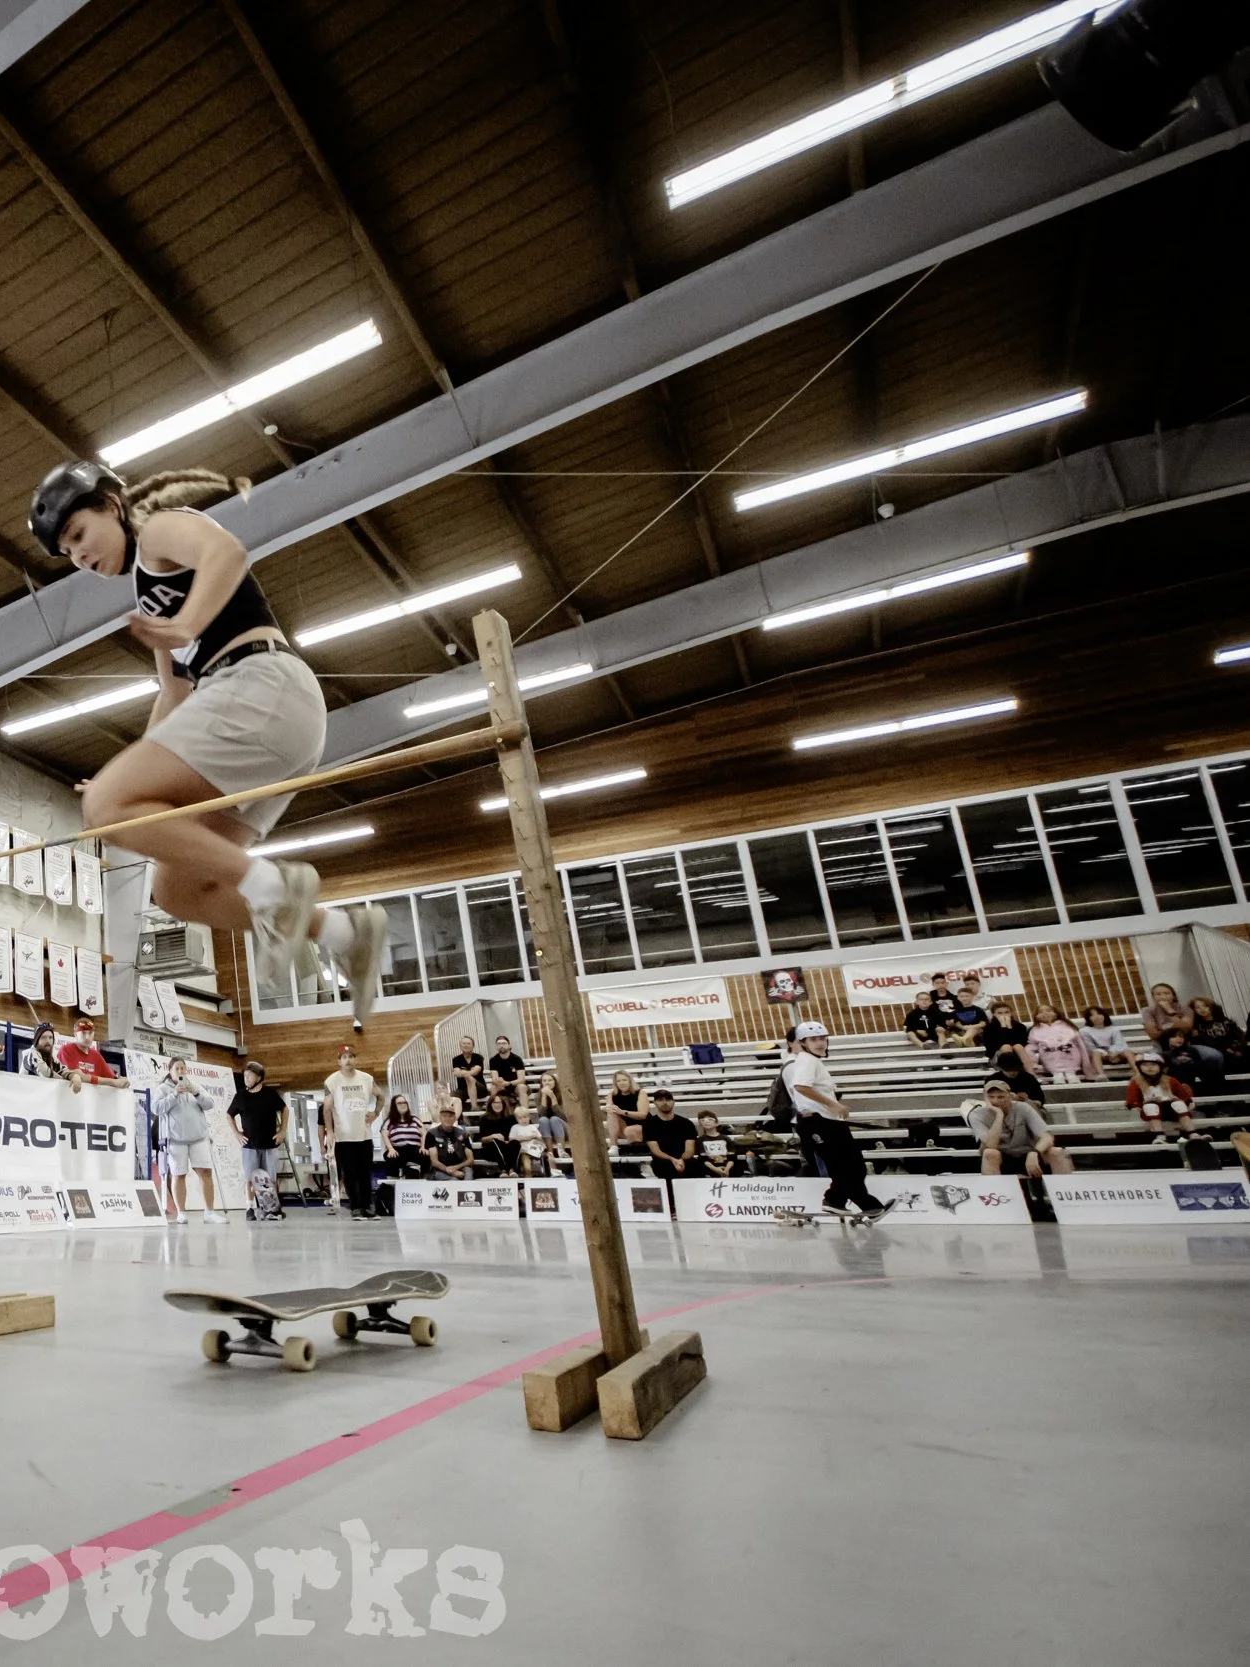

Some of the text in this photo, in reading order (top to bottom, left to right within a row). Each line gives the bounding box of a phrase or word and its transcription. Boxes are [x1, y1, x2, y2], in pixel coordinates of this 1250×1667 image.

[852, 966, 1009, 990] POWELL ERALTA
[596, 993, 720, 1014] POWELL PERALTA
[731, 1182, 795, 1194] Holiday Inn
[1055, 1189, 1163, 1201] QUARTERHORSE
[100, 1198, 134, 1210] TASHME
